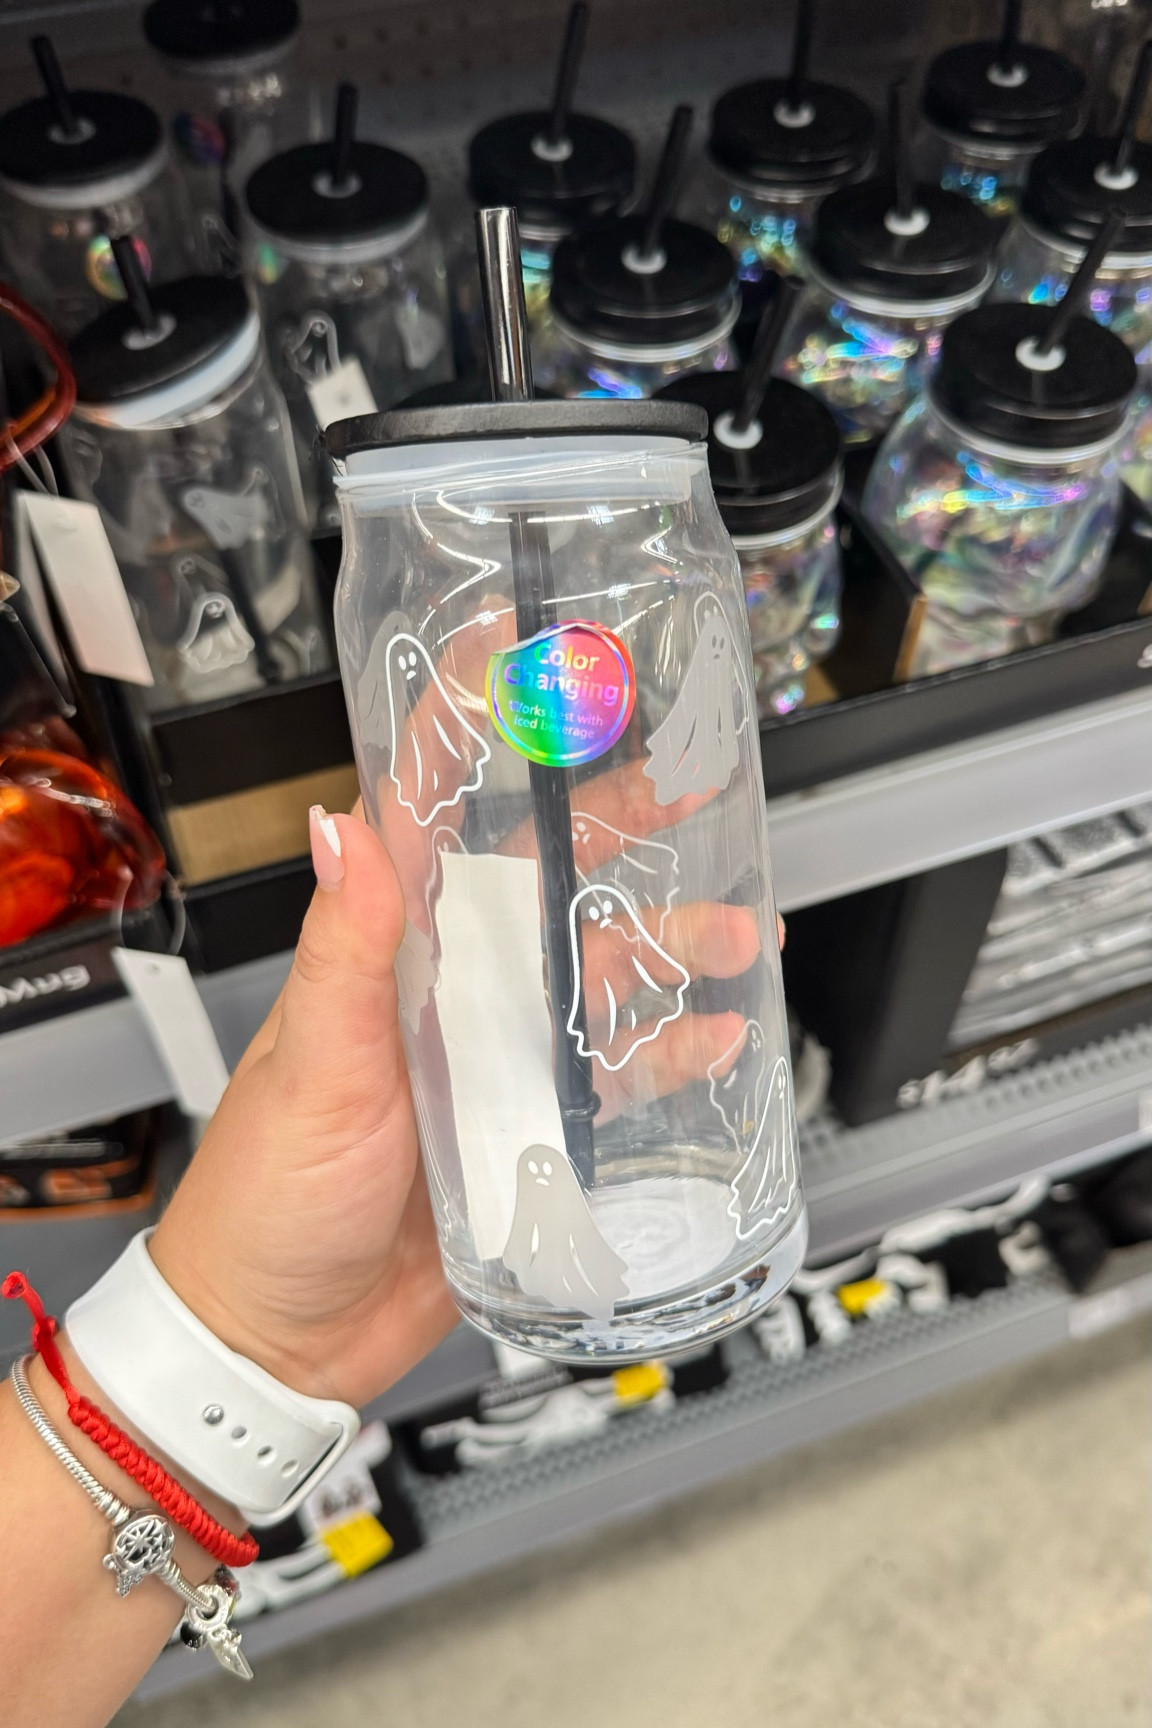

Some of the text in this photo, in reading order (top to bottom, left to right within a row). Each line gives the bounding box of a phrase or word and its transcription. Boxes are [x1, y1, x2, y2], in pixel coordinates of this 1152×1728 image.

[534, 642, 600, 671] Color
[504, 663, 619, 706] Changing
[509, 700, 603, 726] Works best with
[540, 719, 595, 740] beverage
[0, 965, 91, 1008] Mug
